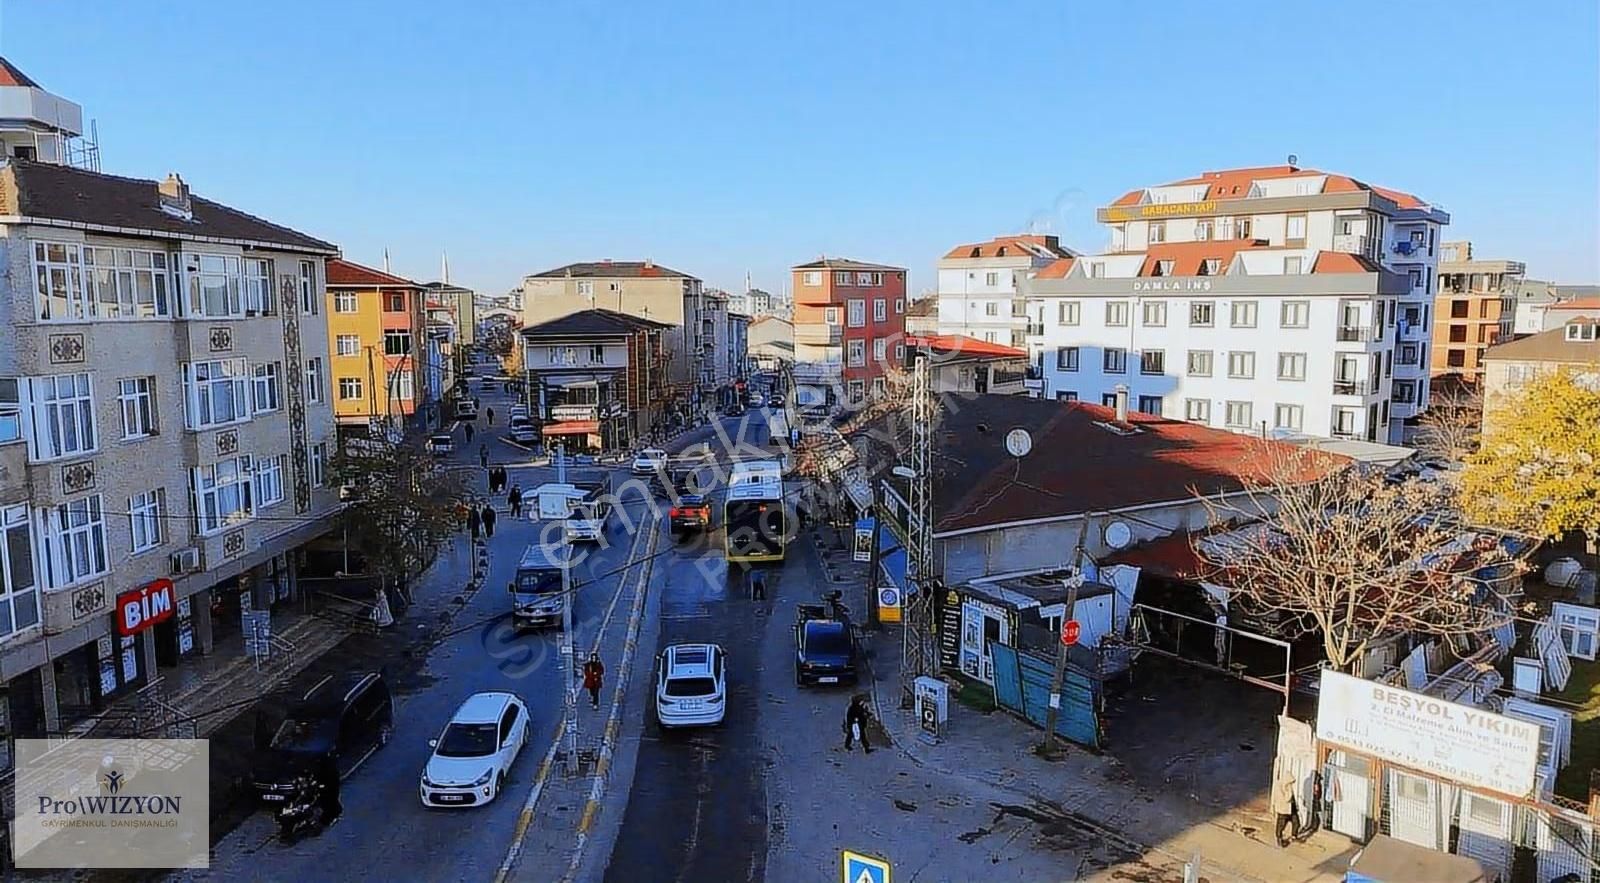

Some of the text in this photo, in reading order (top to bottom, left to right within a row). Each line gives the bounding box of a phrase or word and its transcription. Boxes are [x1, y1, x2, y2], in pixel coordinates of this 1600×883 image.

[1133, 281, 1180, 291] DAMLA
[124, 587, 171, 630] BİM
[1372, 687, 1454, 721] BEŞYOL
[1463, 710, 1530, 741] YIKIM
